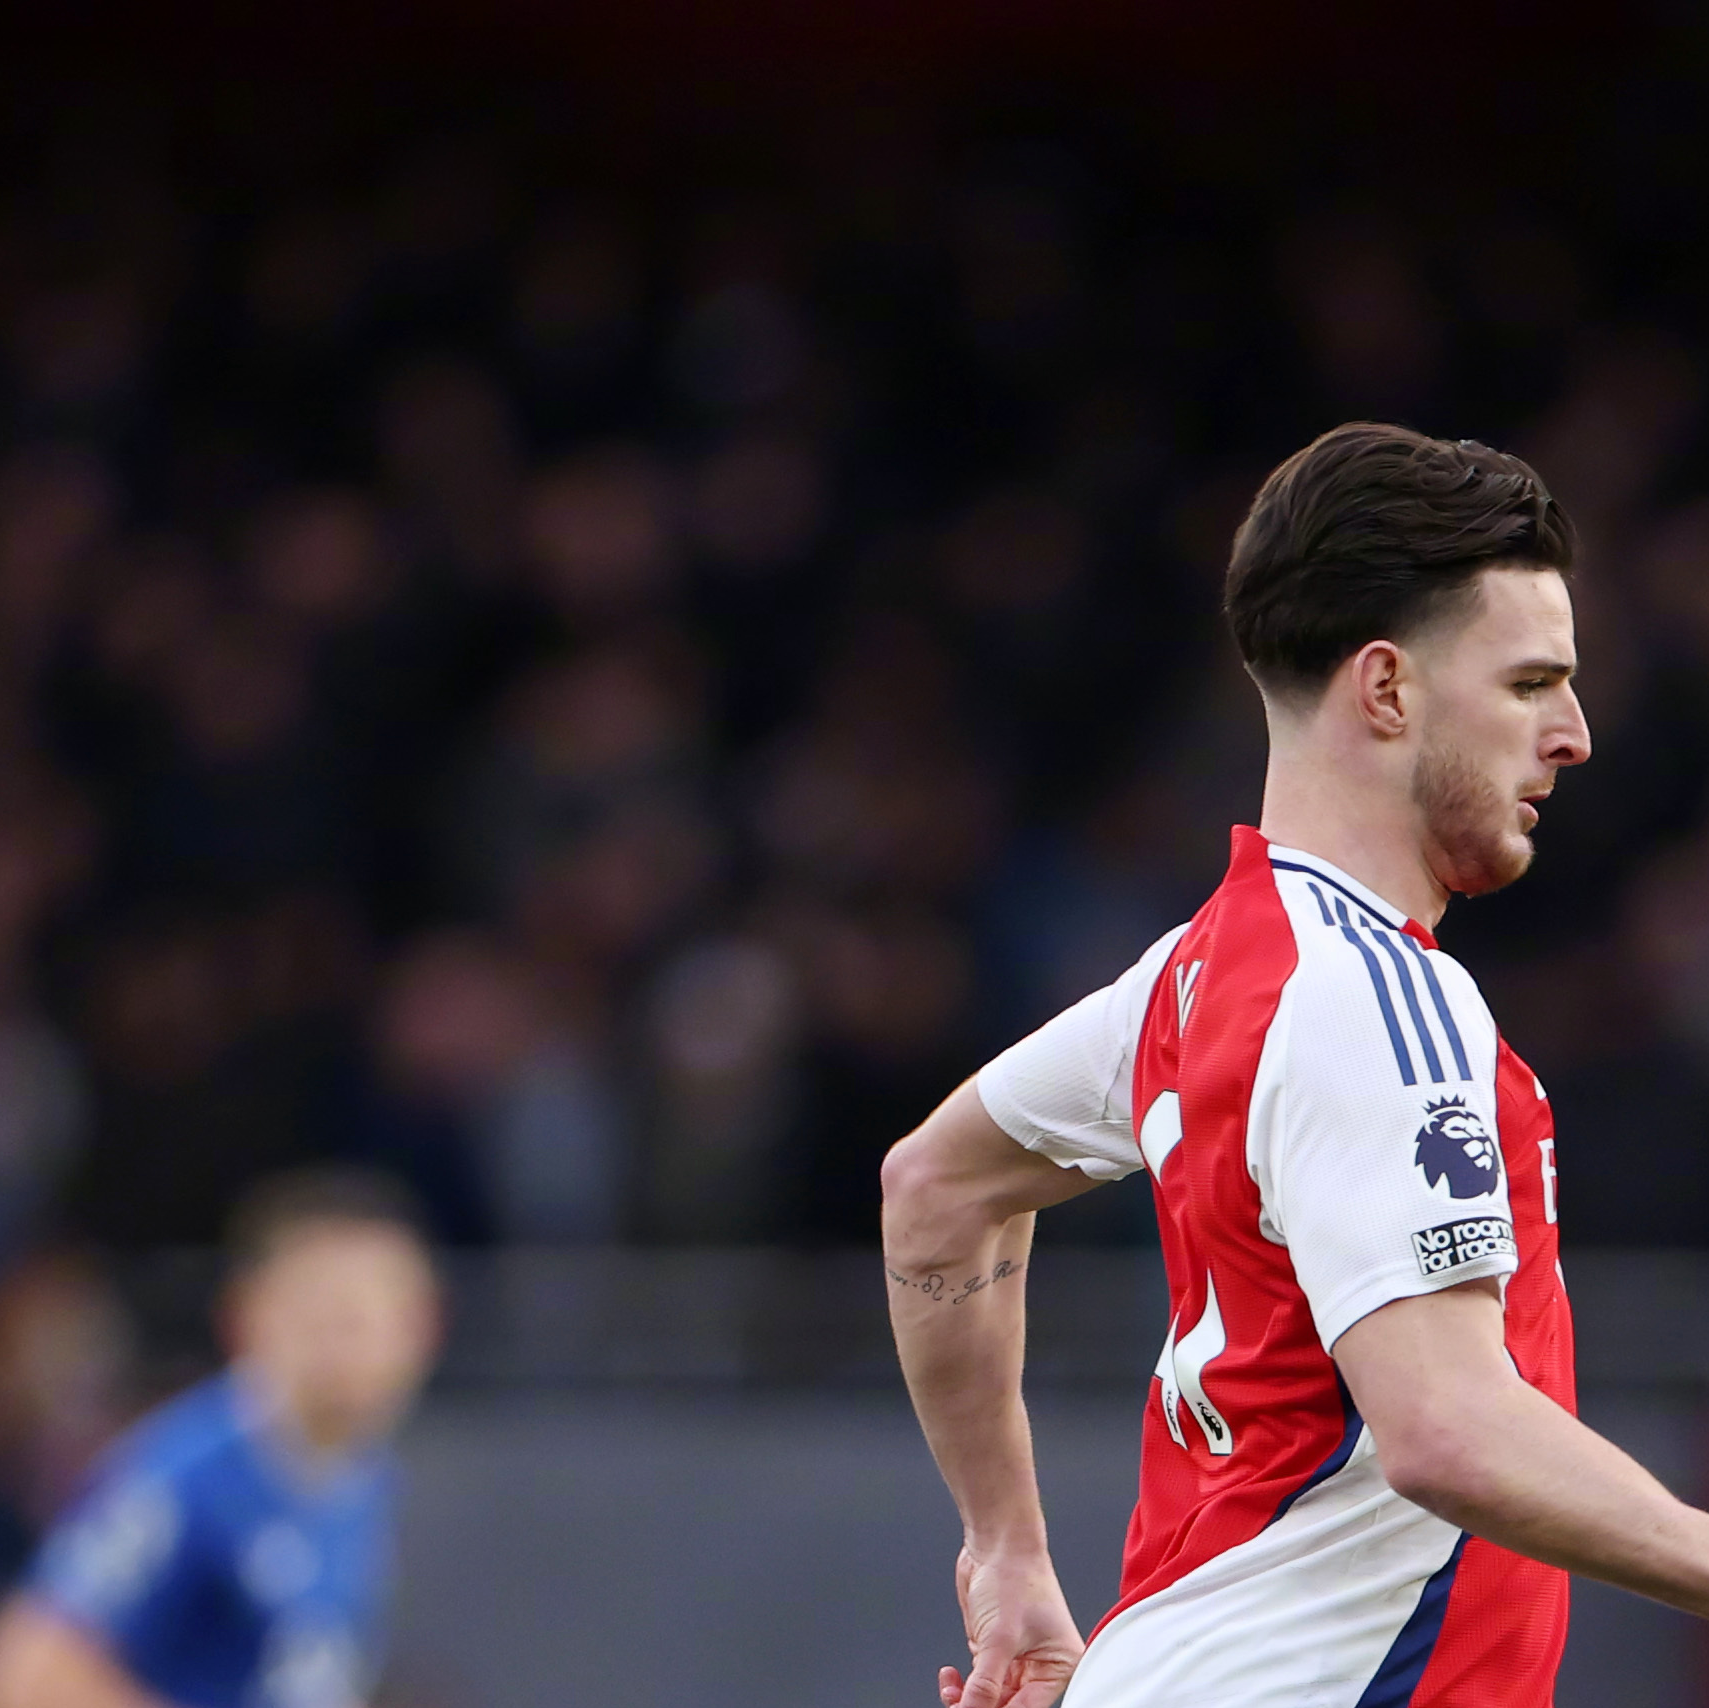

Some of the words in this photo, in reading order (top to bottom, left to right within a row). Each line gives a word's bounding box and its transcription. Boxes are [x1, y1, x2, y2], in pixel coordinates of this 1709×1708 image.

[1412, 1229, 1451, 1254] No
[1452, 1219, 1514, 1244] room
[1418, 1247, 1454, 1275] for
